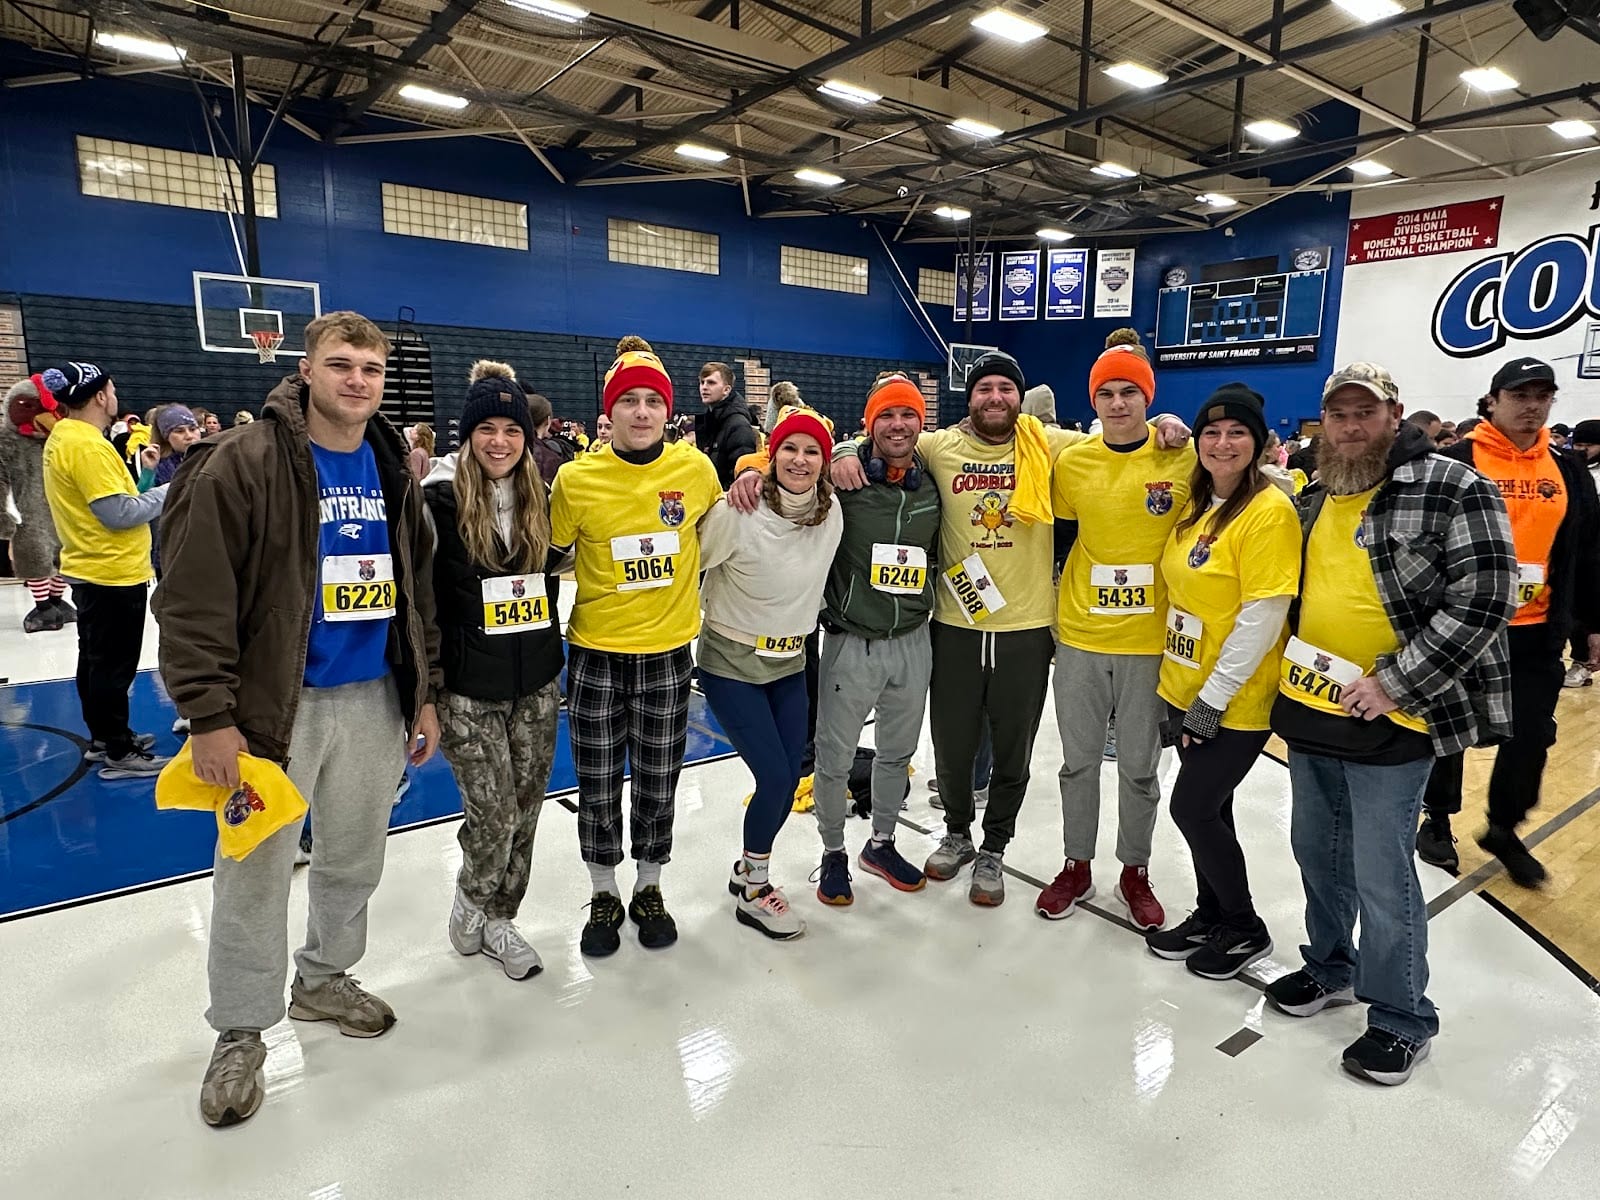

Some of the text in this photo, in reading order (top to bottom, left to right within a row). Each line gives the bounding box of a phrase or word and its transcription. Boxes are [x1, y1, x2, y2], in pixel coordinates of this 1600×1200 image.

[1394, 220, 1447, 237] DIVISION II
[1397, 209, 1447, 226] 2014 NAIA
[1363, 226, 1480, 250] WOMEN'S BASKETBALL
[1367, 237, 1473, 260] NATIONAL CHAMPION
[1160, 348, 1260, 361] UNIVERSITY OF SAINT FRANCIS
[624, 556, 675, 581] 5064
[879, 566, 919, 587] 6244
[335, 583, 392, 611] 6228
[951, 570, 984, 615] 5098
[1098, 587, 1146, 607] 5433
[494, 599, 543, 625] 5434
[1166, 630, 1195, 659] 6469
[1288, 664, 1343, 704] 6470
